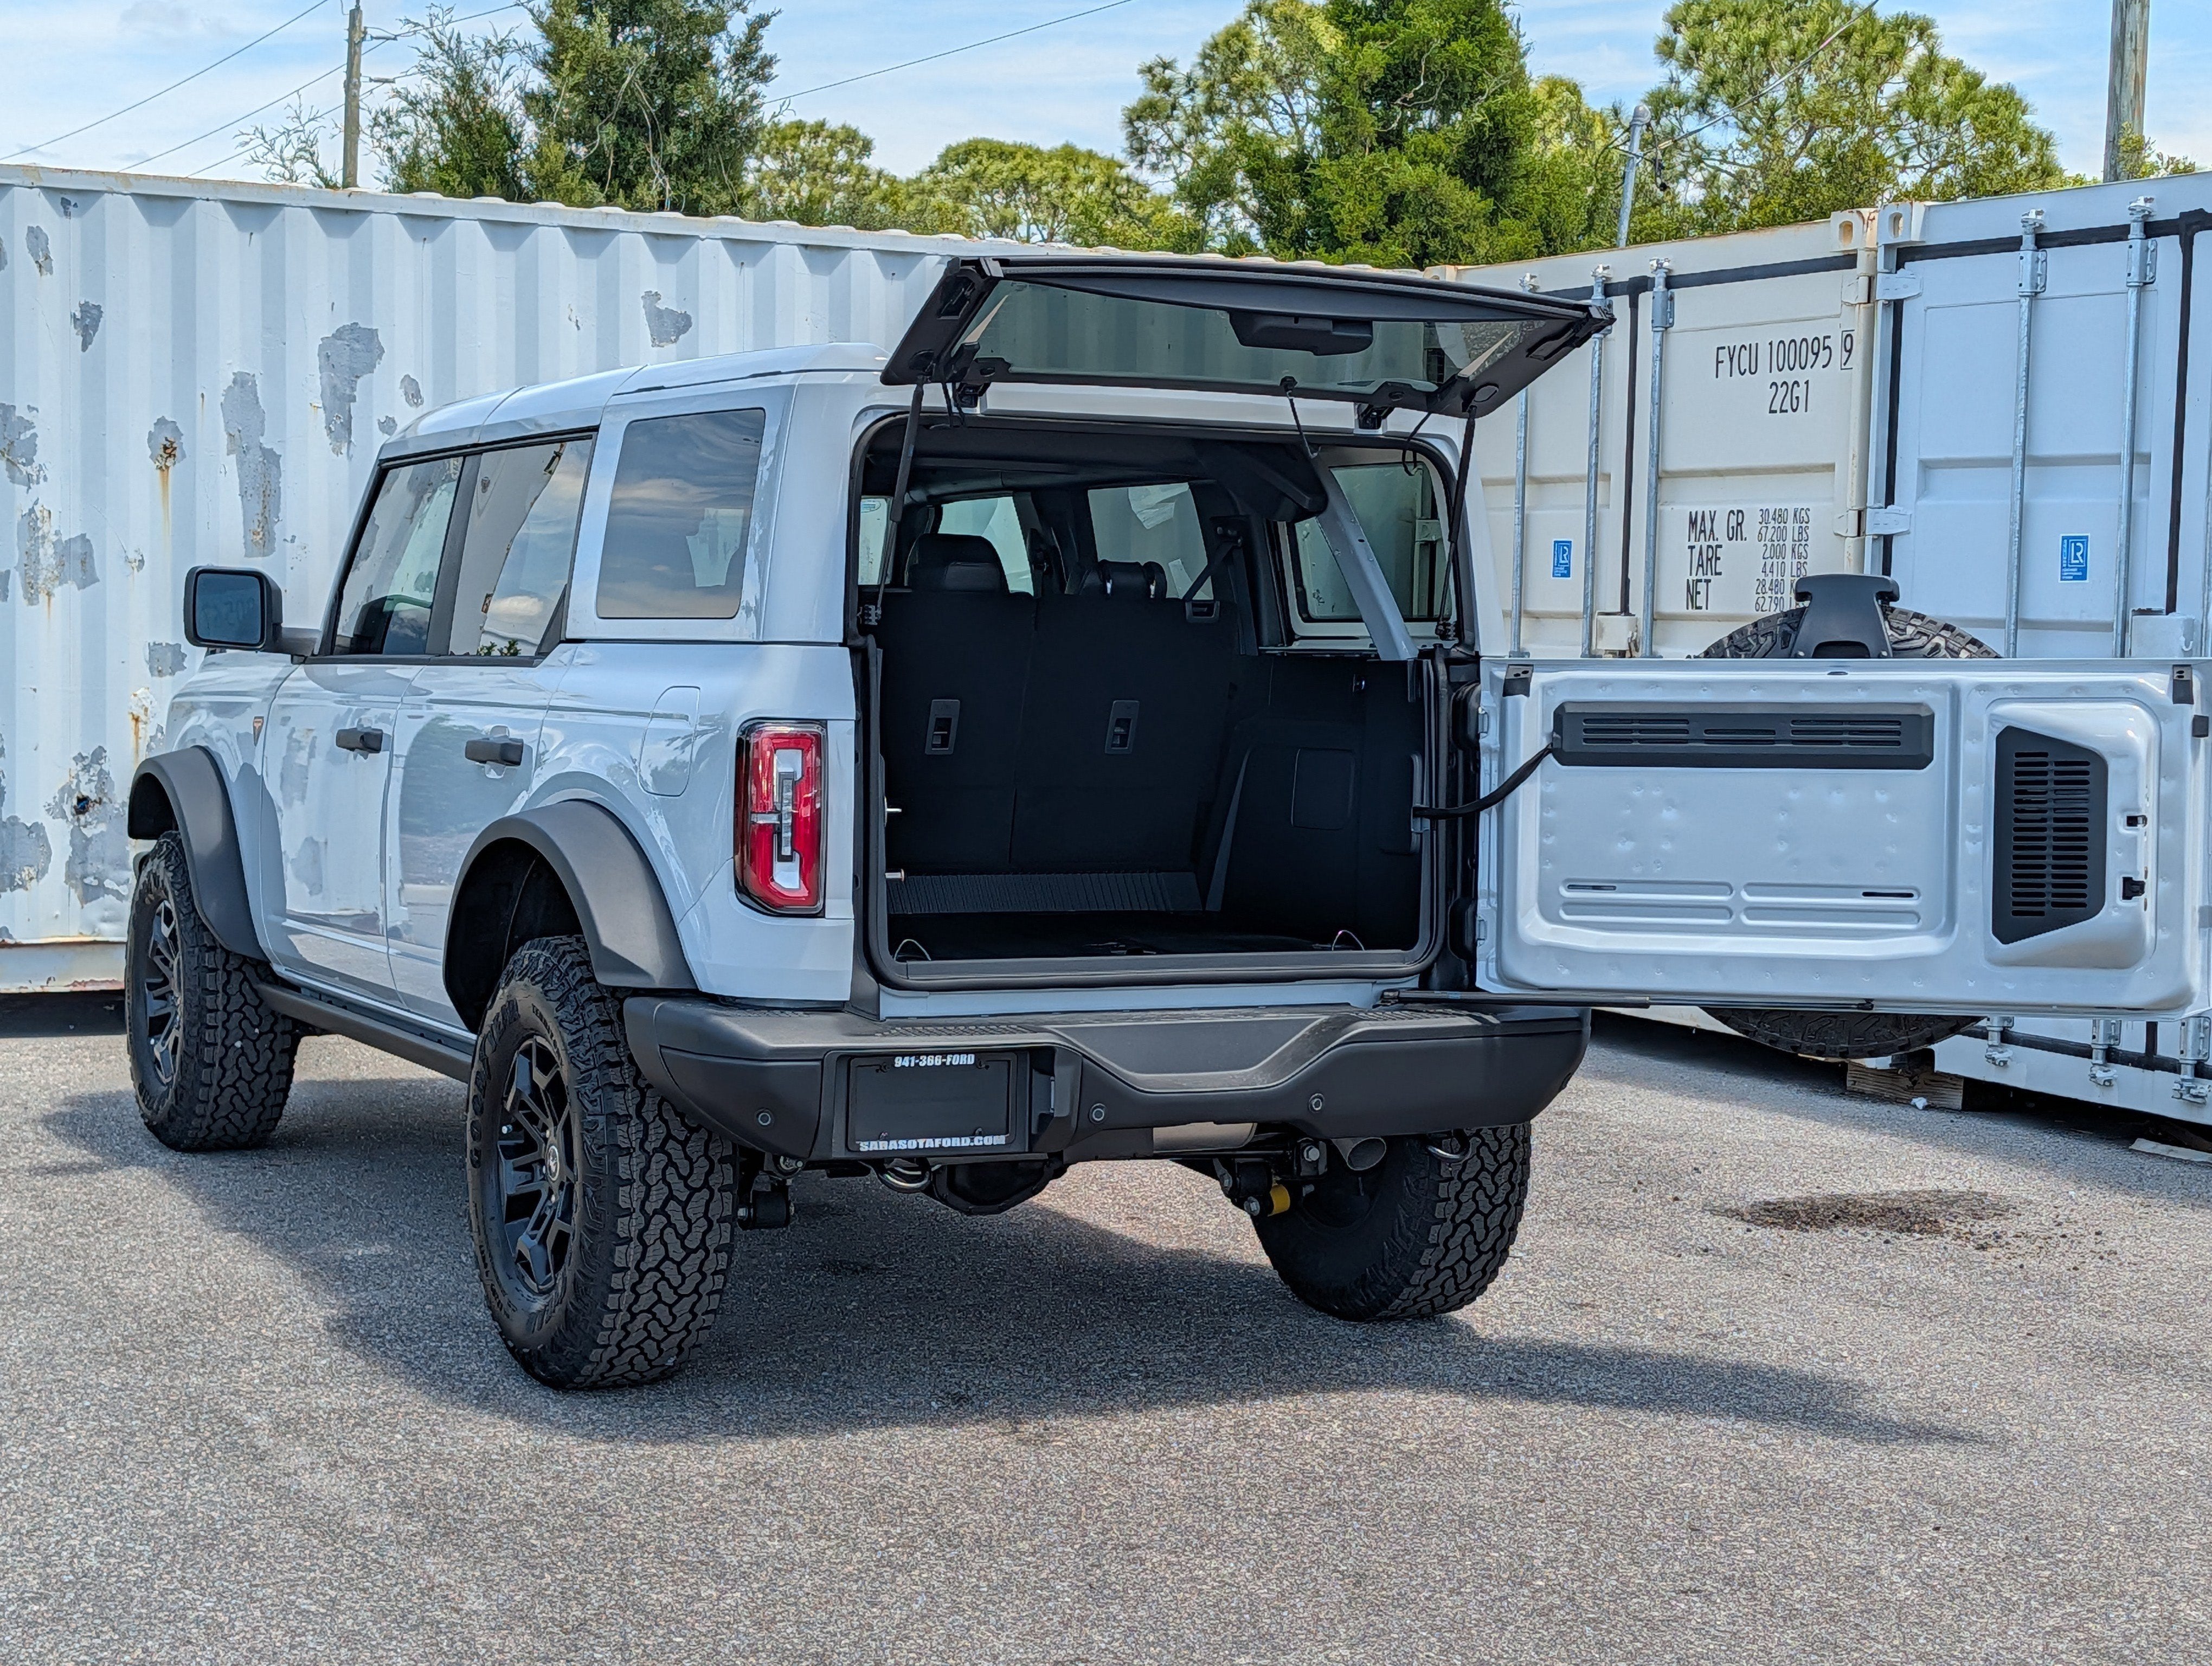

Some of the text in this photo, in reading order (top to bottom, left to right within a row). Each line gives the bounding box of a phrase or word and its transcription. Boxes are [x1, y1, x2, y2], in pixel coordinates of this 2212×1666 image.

[1715, 334, 1854, 379] FYCU 100095 9
[1769, 380, 1809, 414] 22G1
[1688, 509, 1747, 542] MAX. GR.
[1792, 508, 1810, 524] KGS
[1792, 526, 1810, 542] LBS
[1687, 544, 1723, 576] TARE
[1791, 543, 1809, 560] KGS
[1790, 561, 1808, 578] LBS
[1686, 578, 1712, 611] NET
[859, 1135, 1006, 1152] SARASOTAFORD.COM
